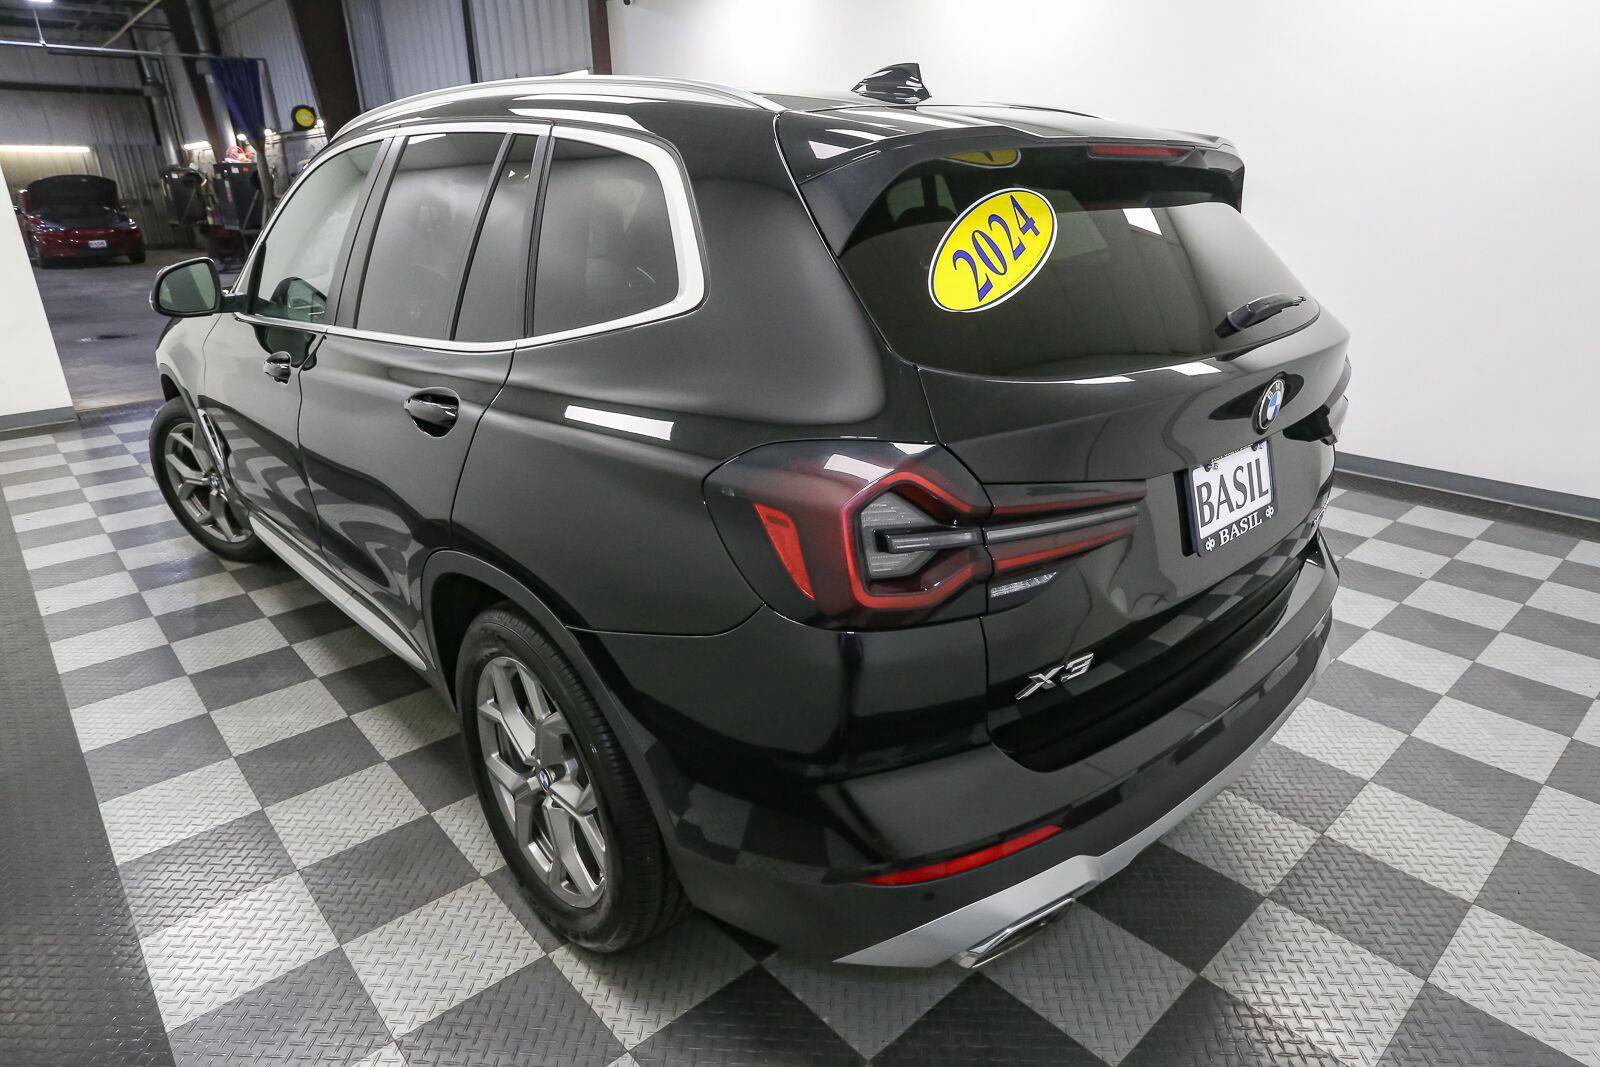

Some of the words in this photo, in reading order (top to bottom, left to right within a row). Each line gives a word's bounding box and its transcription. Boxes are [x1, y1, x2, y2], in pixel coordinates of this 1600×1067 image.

[952, 195, 1040, 302] 2024
[1196, 458, 1269, 529] BASIL
[1219, 511, 1263, 547] BASIL
[1014, 652, 1094, 701] X3
